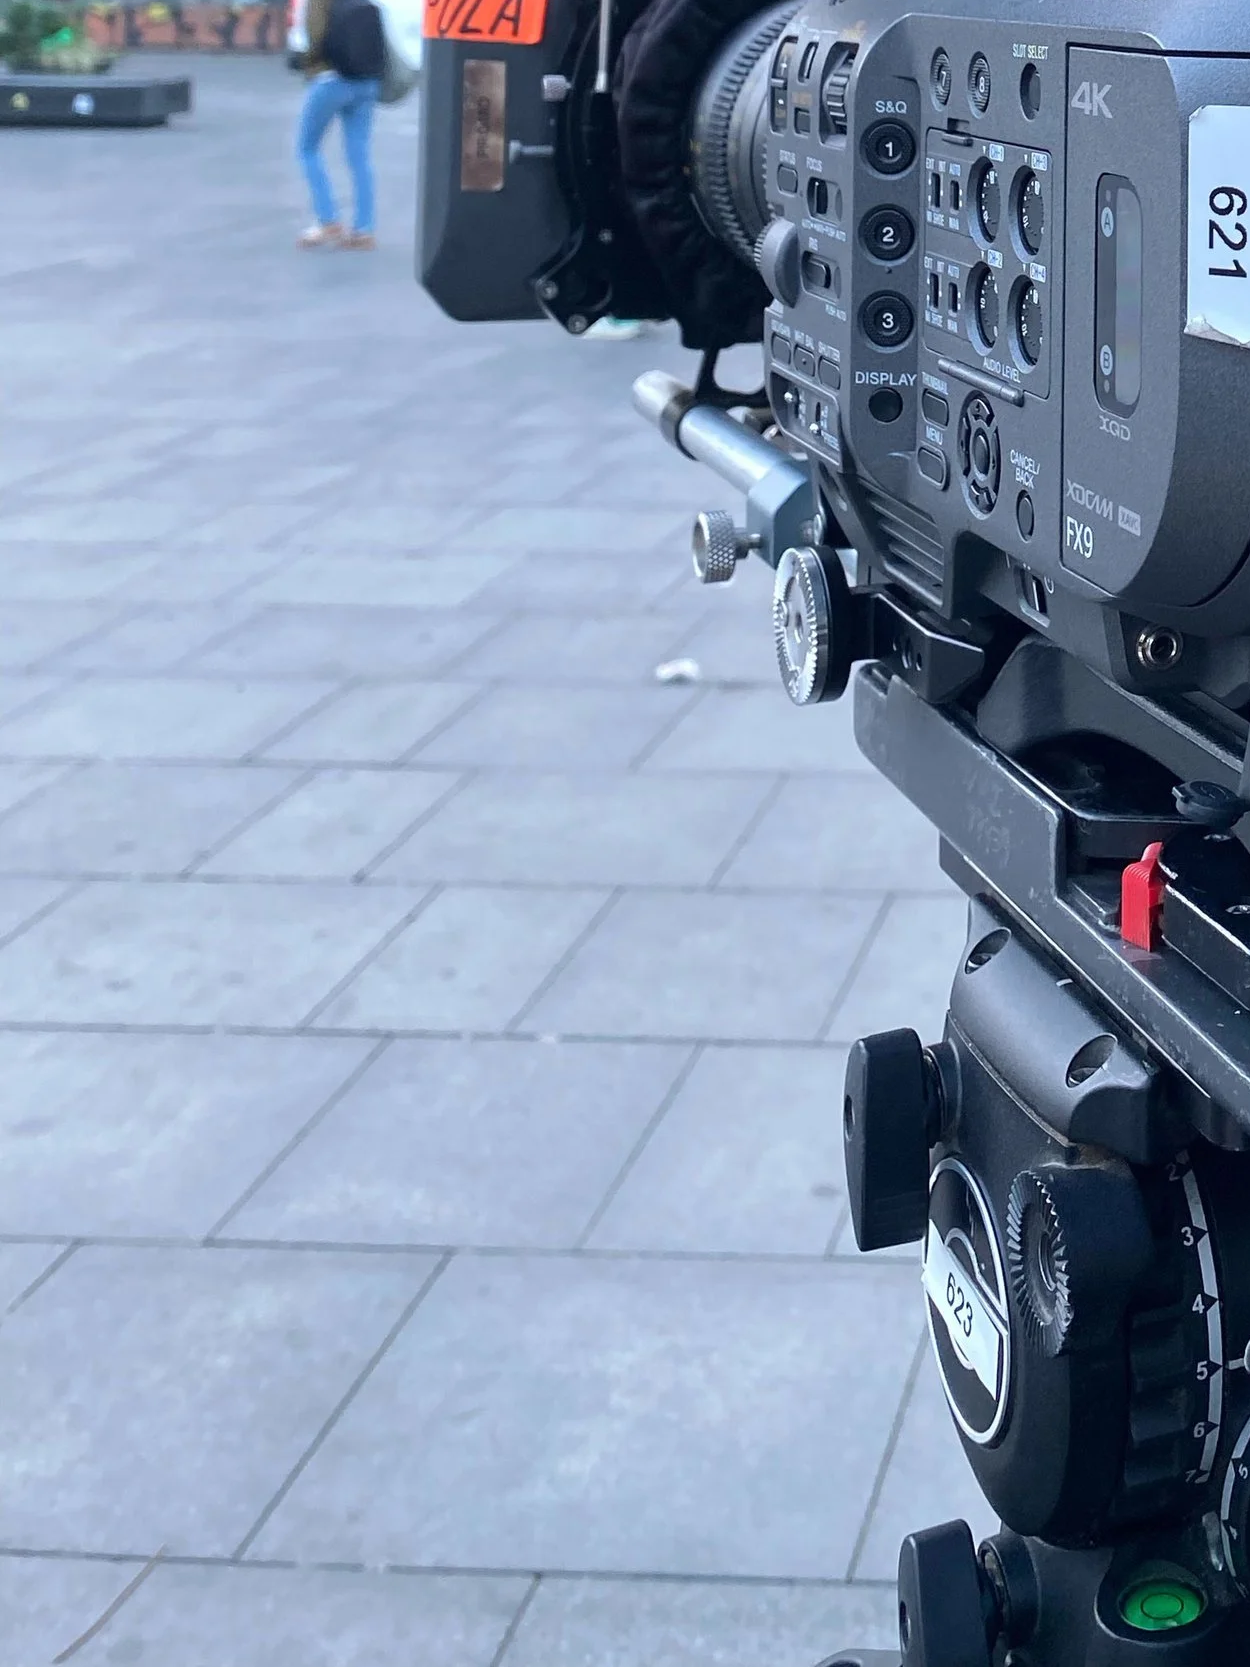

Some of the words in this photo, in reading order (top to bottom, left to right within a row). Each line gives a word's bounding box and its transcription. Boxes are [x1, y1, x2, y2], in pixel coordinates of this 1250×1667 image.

[1012, 43, 1027, 58] SLOT
[1028, 44, 1048, 60] SELECT
[941, 71, 947, 87] 7
[979, 76, 985, 93] 8
[875, 100, 908, 114] S&Q
[1071, 81, 1113, 119] 4K
[885, 141, 893, 157] 1
[1103, 212, 1112, 229] A
[882, 226, 894, 243] 2
[1208, 186, 1248, 278] 621
[882, 312, 894, 329] 3
[1103, 352, 1112, 369] B
[855, 371, 918, 386] DISPLAY
[925, 426, 943, 445] MENU
[1099, 415, 1131, 441] XQD
[1015, 467, 1035, 489] BACK
[1066, 515, 1094, 559] FX9
[1181, 1226, 1195, 1247] 3
[946, 1272, 974, 1337] 623
[1192, 1294, 1206, 1315] 4
[1196, 1360, 1209, 1382] 5
[1193, 1421, 1206, 1439] 6
[1238, 1463, 1249, 1480] 5
